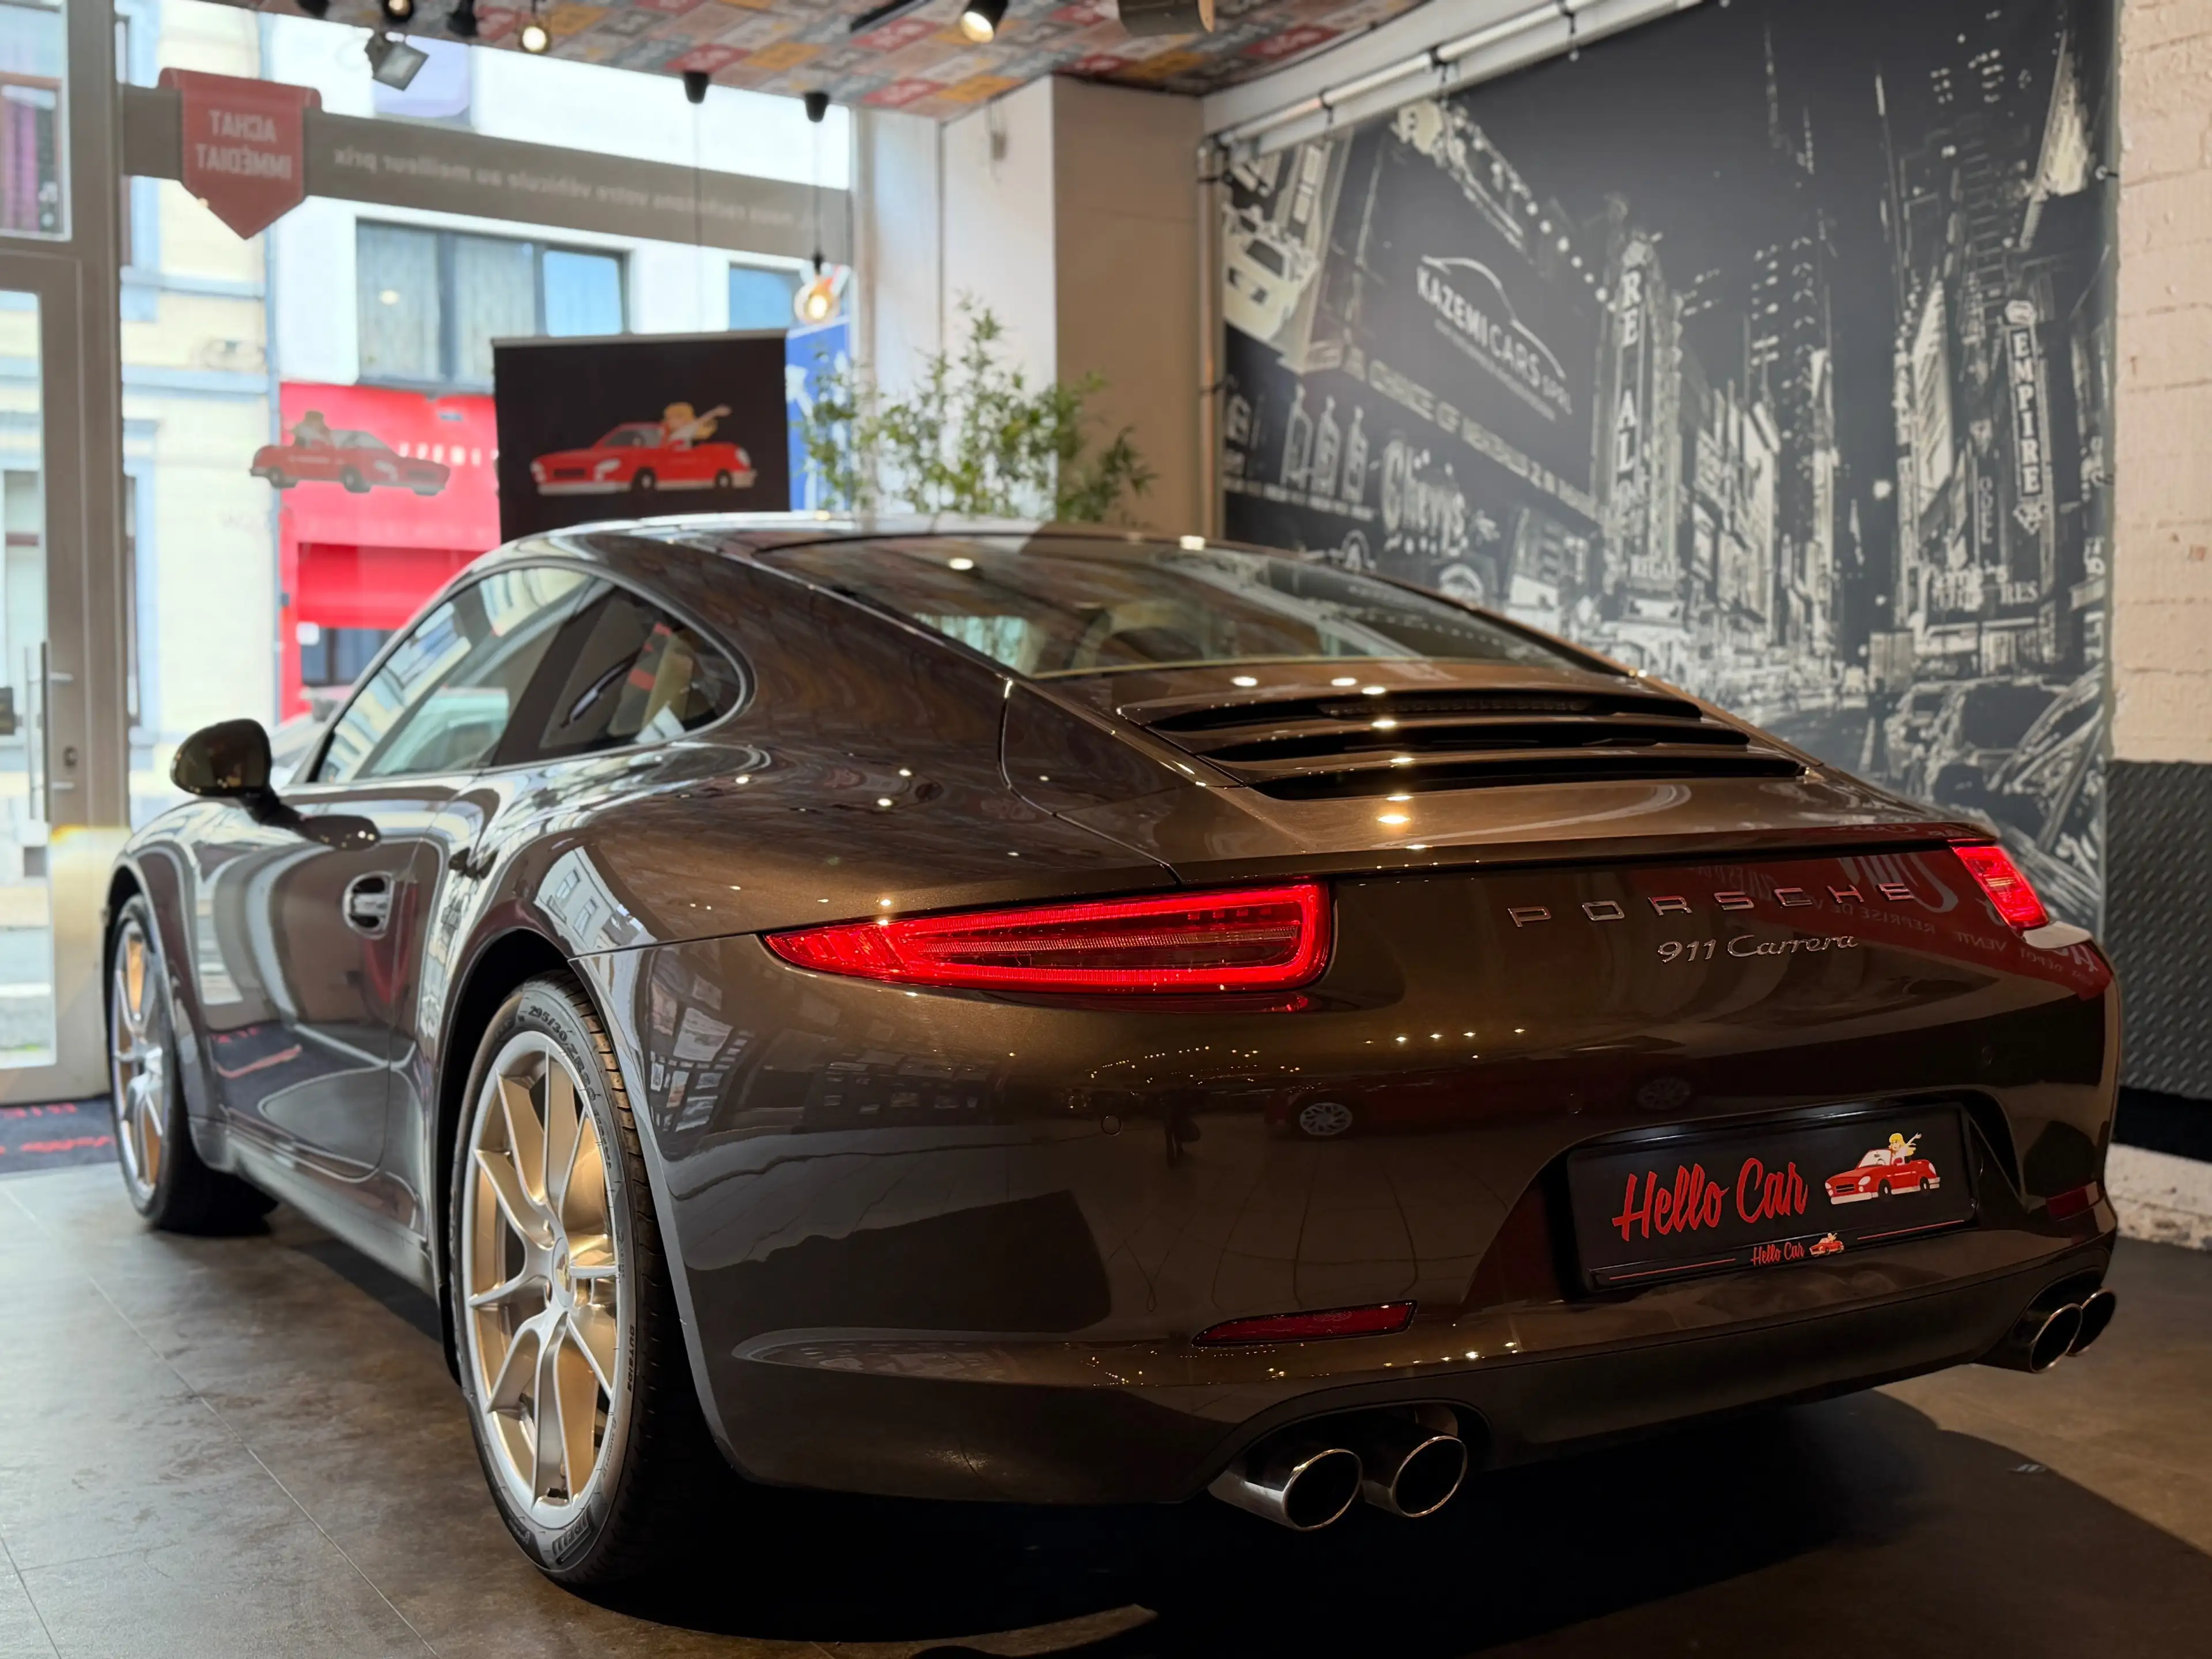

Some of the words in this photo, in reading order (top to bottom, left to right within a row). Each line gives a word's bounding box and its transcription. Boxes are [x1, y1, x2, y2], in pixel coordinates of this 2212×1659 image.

[2012, 331, 2042, 494] EMPIRE
[1508, 882, 1915, 929] PORSCHE
[1657, 938, 1717, 964] 911
[1727, 934, 1859, 959] Carrera
[528, 1005, 568, 1041] 295/30
[1612, 1164, 1730, 1242] Hello
[1736, 1158, 1808, 1224] Car
[1751, 1244, 1781, 1266] Hello
[1783, 1241, 1805, 1260] Car
